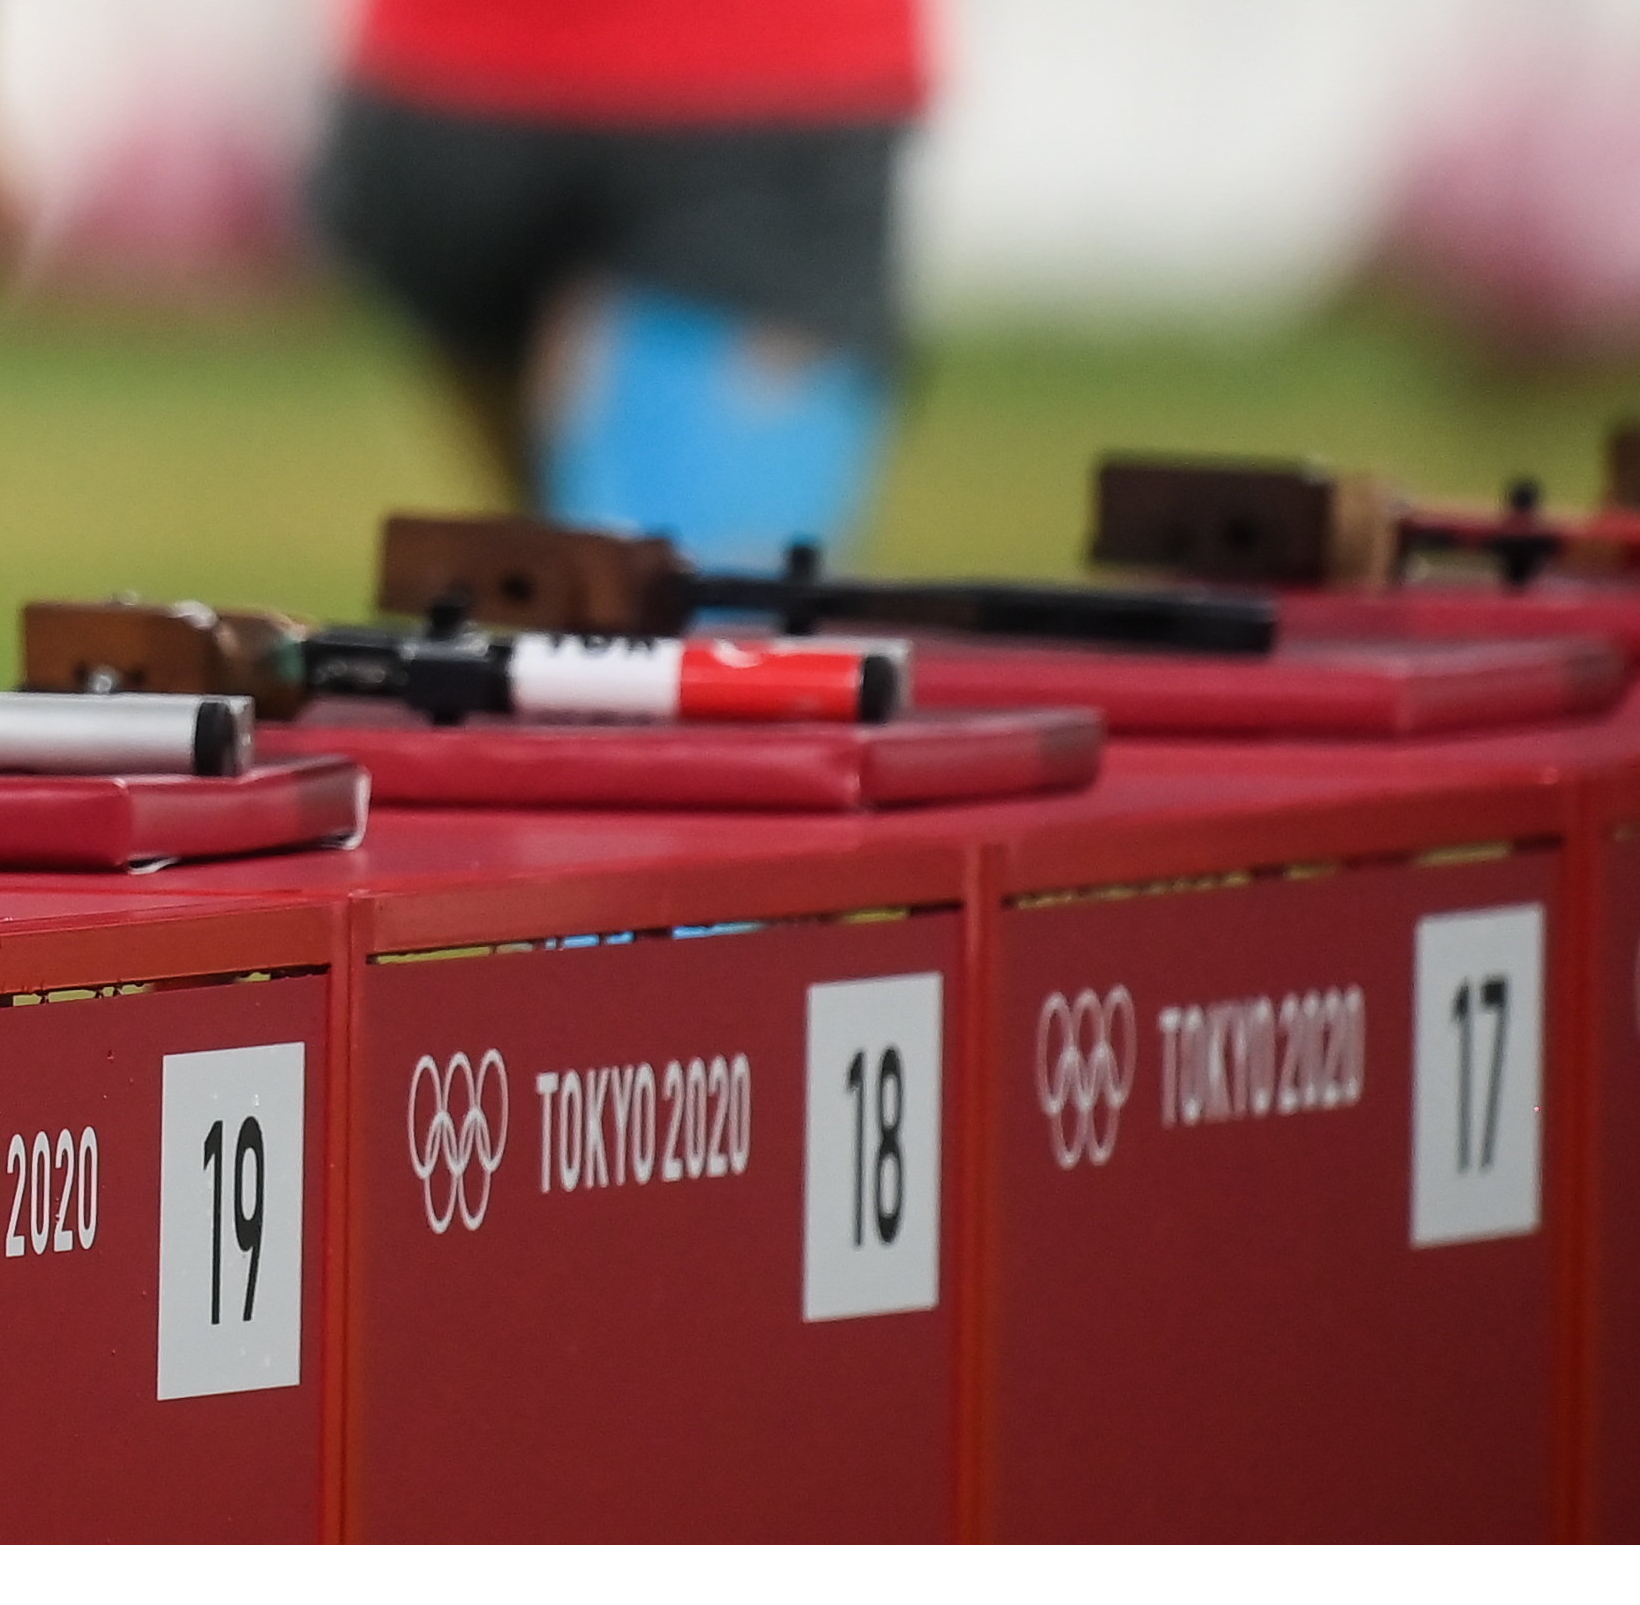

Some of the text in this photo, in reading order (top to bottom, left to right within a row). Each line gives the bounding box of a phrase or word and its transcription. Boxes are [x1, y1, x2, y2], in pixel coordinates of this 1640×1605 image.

[536, 1053, 751, 1194] TOKYO 2020
[1277, 984, 1365, 1115] 2020
[1452, 974, 1508, 1173] 17
[5, 1126, 99, 1257] 2020
[203, 1116, 265, 1325] 19
[845, 1043, 904, 1249] 18
